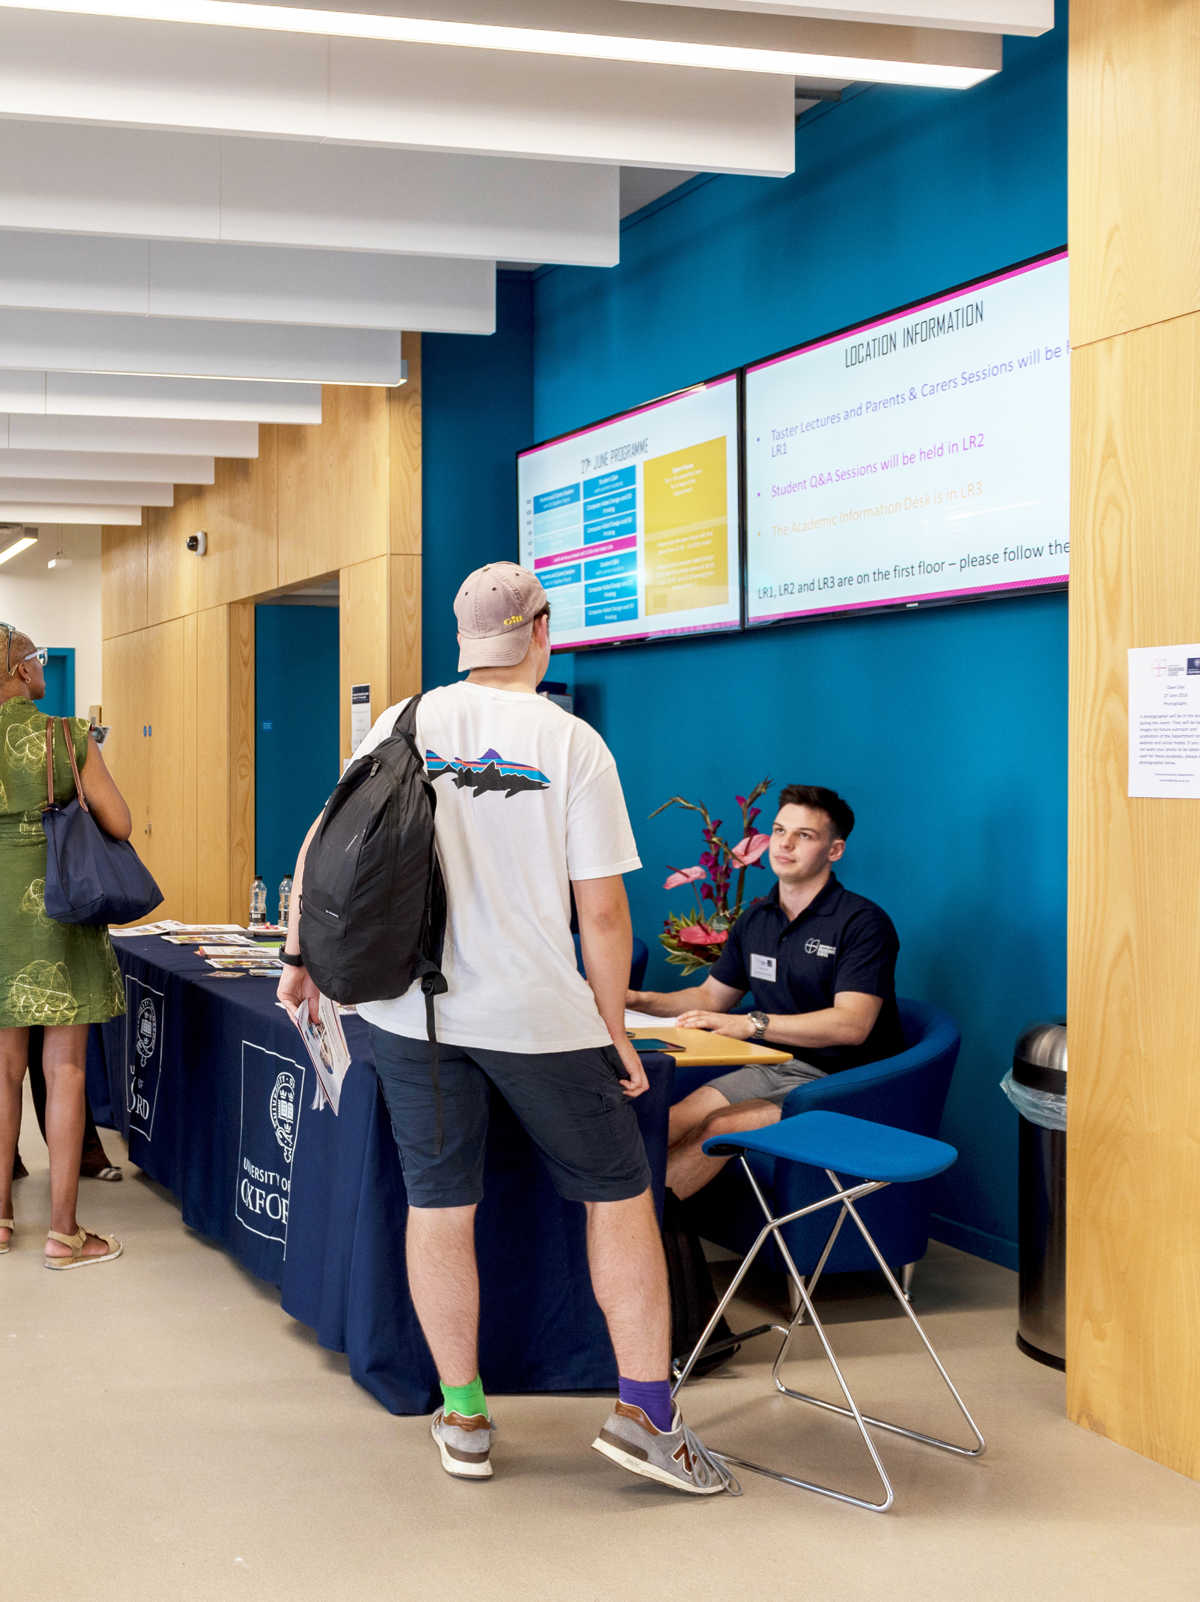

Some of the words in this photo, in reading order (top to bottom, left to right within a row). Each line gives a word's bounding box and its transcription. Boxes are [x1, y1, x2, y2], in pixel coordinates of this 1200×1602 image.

[845, 331, 897, 368] LOCATION
[902, 300, 984, 348] INFORMATION
[771, 425, 798, 442] Taster
[800, 410, 841, 434] Lectures
[843, 402, 863, 421] and
[865, 392, 906, 414] Parents
[908, 386, 918, 402] &
[920, 377, 958, 399] Carers
[960, 361, 1014, 387] Sessions
[1017, 347, 1041, 369] will
[1044, 342, 1063, 361] be
[593, 451, 608, 470] JUNE
[610, 437, 648, 462] PROGRAMME
[771, 442, 788, 459] LR1
[771, 478, 807, 499] Student
[809, 472, 833, 490] Q&A
[834, 463, 878, 483] Sessions
[880, 456, 899, 472] will
[902, 452, 916, 466] be
[919, 444, 944, 463] held
[948, 440, 959, 456] in
[962, 432, 985, 452] LR2
[772, 524, 788, 537] The
[791, 514, 837, 534] Academic
[839, 501, 901, 525] Information
[903, 493, 931, 512] Desk
[933, 490, 944, 505] is
[946, 488, 958, 504] in
[961, 480, 983, 500] LR3
[758, 583, 777, 600] LR1,
[779, 581, 795, 597] LR2
[797, 577, 815, 594] and
[817, 576, 835, 592] LR3
[837, 572, 854, 588] are
[857, 570, 870, 584] on
[873, 565, 891, 582] the
[893, 562, 915, 579] first
[918, 559, 945, 576] floor
[959, 550, 999, 570] please
[1003, 541, 1044, 563] follow
[1048, 538, 1070, 556] the
